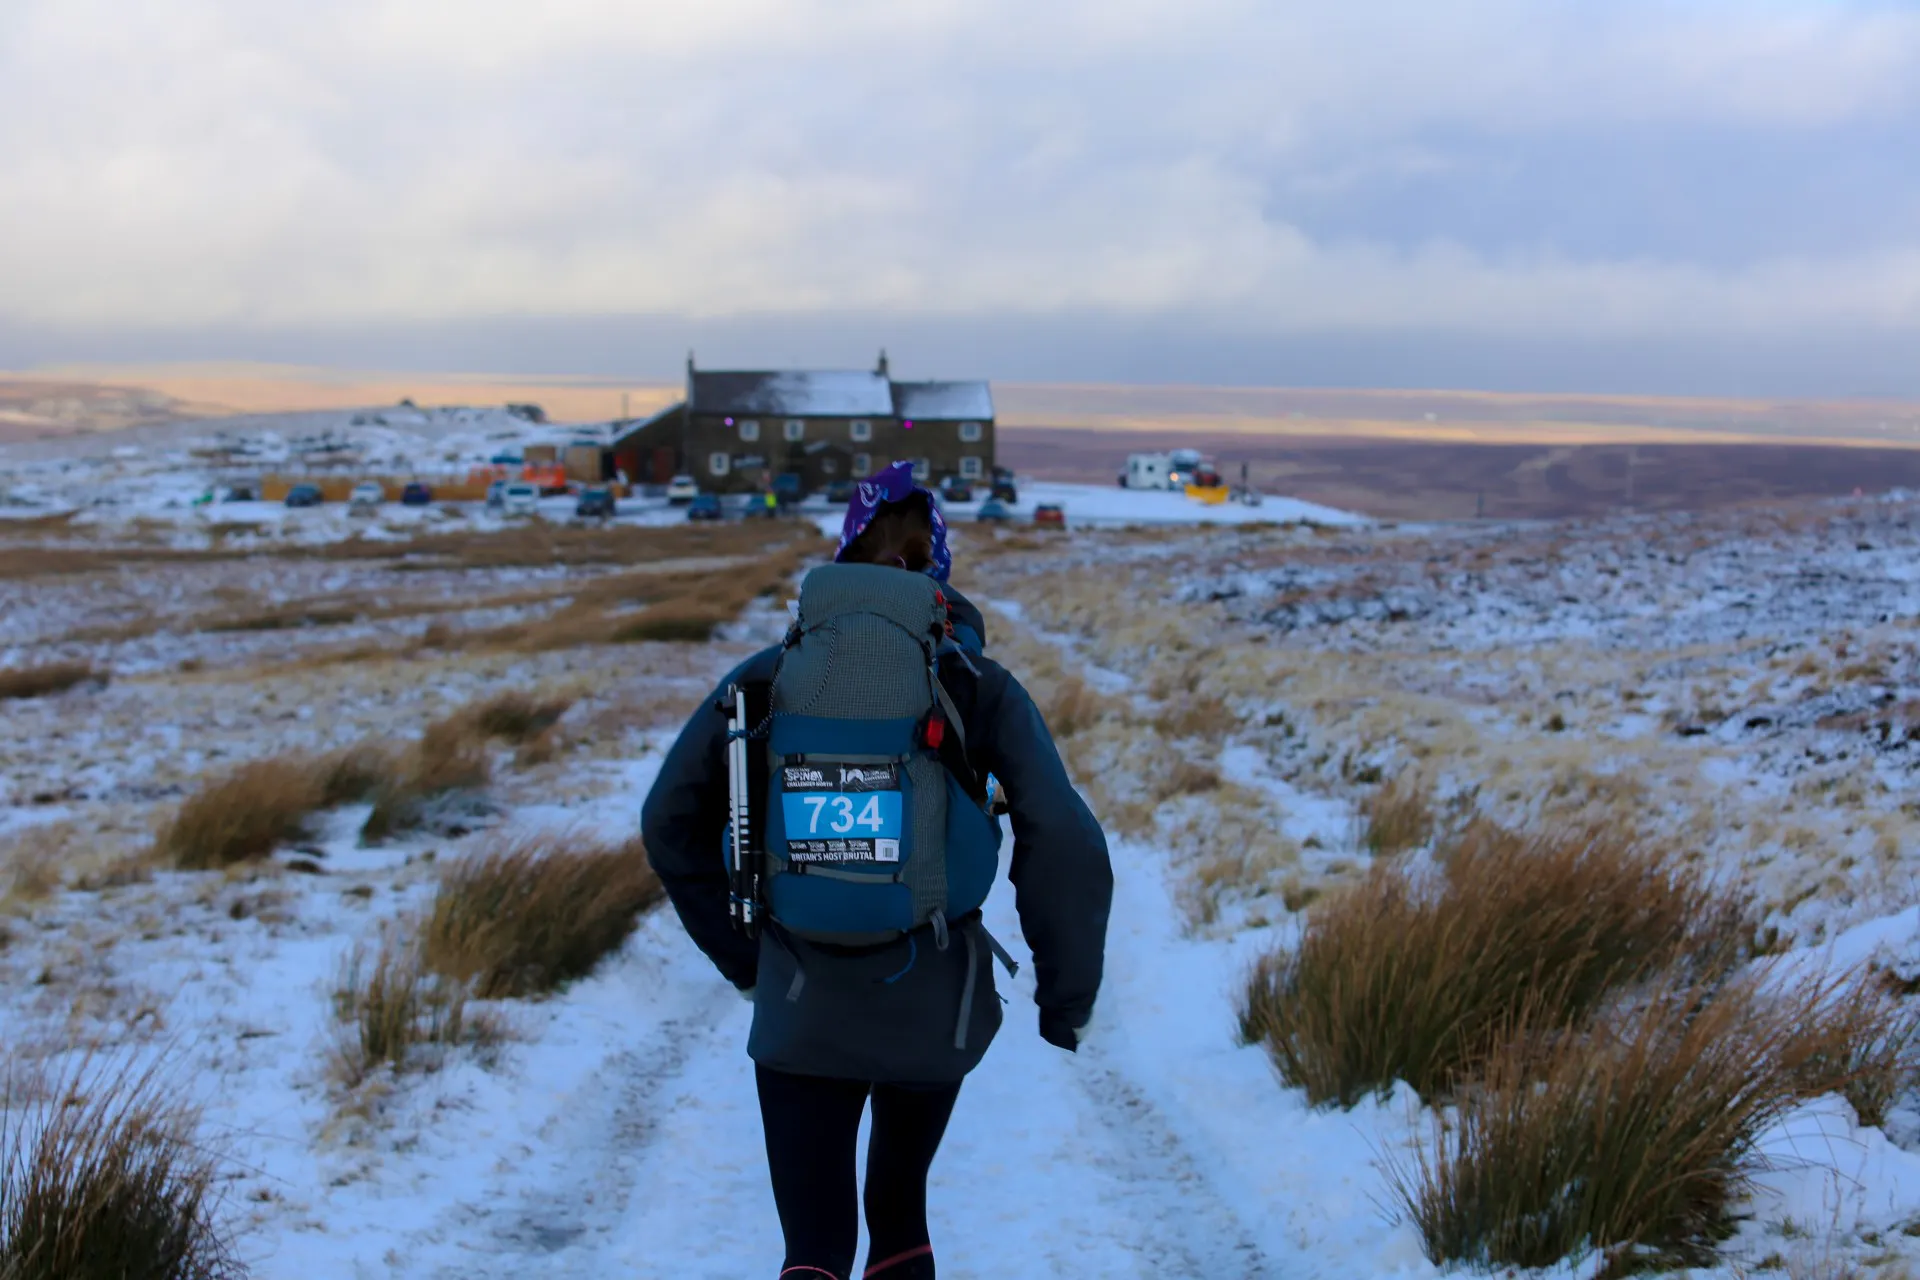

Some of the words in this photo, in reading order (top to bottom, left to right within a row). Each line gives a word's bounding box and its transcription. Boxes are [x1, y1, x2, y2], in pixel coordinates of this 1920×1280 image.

[803, 795, 884, 834] 734
[823, 851, 842, 861] MOST
[843, 851, 874, 861] BRUTAL
